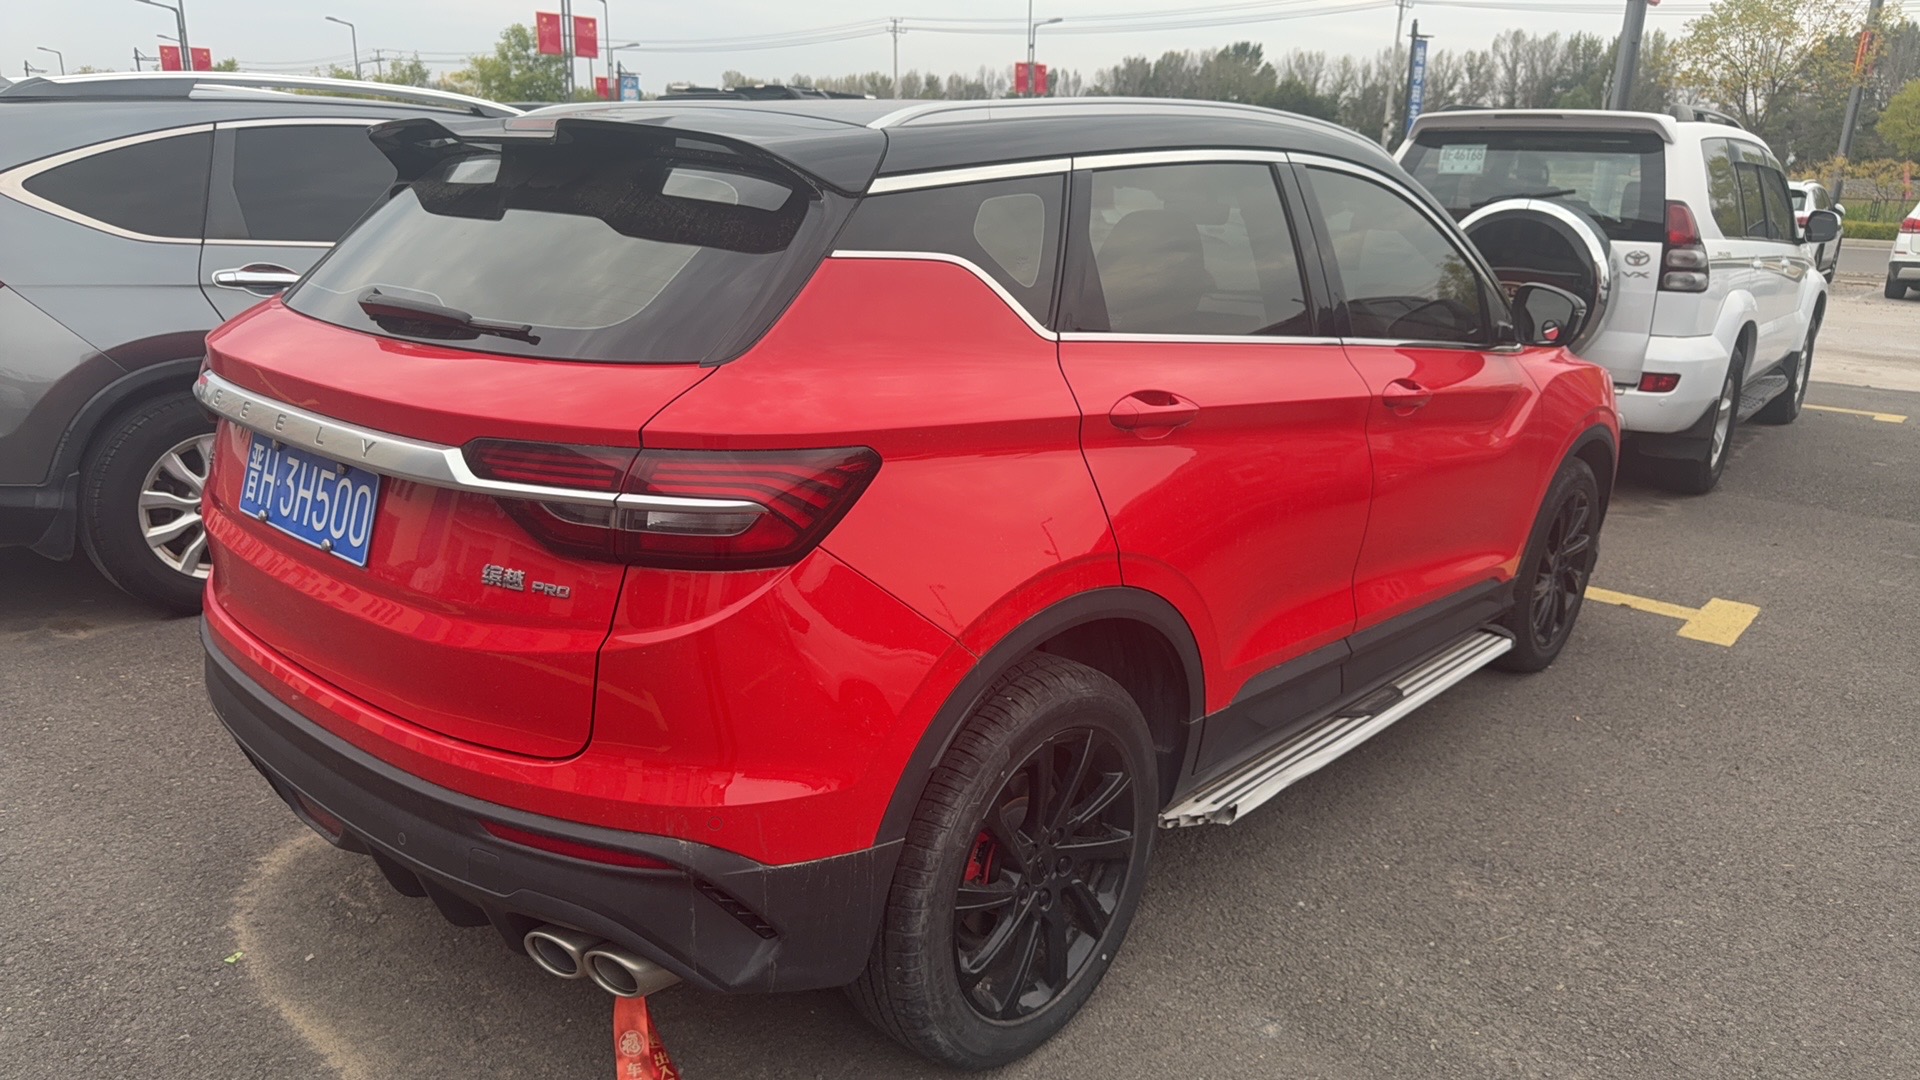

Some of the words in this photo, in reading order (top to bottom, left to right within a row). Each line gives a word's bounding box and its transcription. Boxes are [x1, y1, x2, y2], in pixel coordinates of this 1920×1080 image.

[1622, 270, 1650, 279] VX
[482, 563, 525, 592] 缤越
[531, 580, 570, 599] PRO
